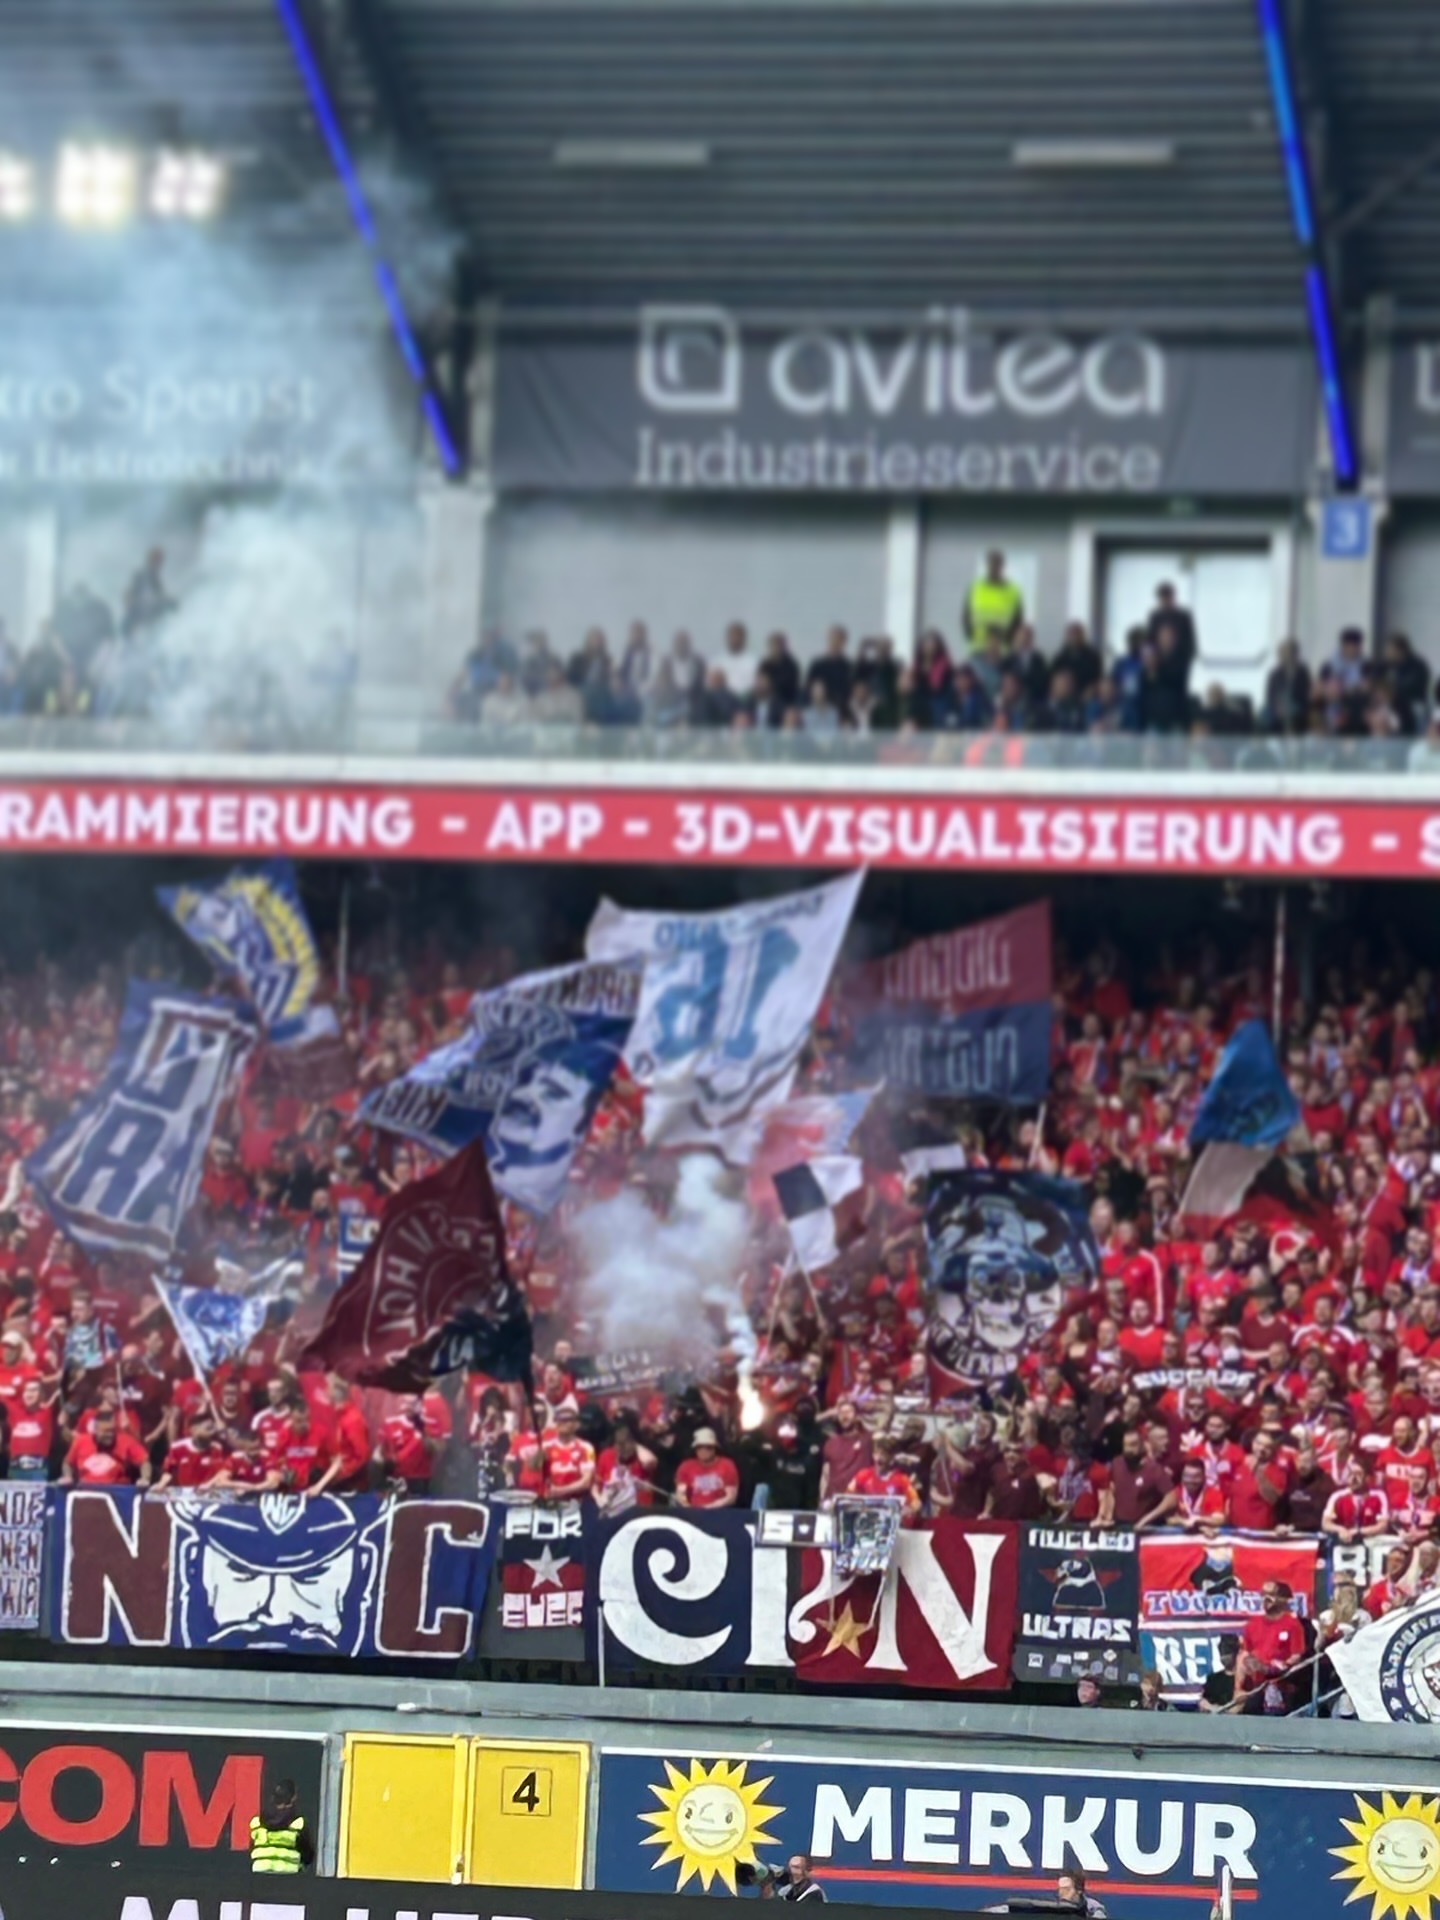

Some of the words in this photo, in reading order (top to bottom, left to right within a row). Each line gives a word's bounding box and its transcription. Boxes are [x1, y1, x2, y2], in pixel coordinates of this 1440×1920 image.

[769, 308, 1166, 416] avitea
[634, 430, 1161, 489] Industrieservice
[1333, 508, 1360, 550] 3
[0, 791, 413, 847] RAMMIERUNG
[485, 803, 602, 852] APP
[673, 804, 1343, 867] 3D-VISUALISIERUNG
[504, 1504, 584, 1541] FOR
[375, 1499, 491, 1659] C
[1022, 1611, 1133, 1643] ULTRAS
[511, 1771, 540, 1813] 4
[810, 1784, 1259, 1882] MERKUR
